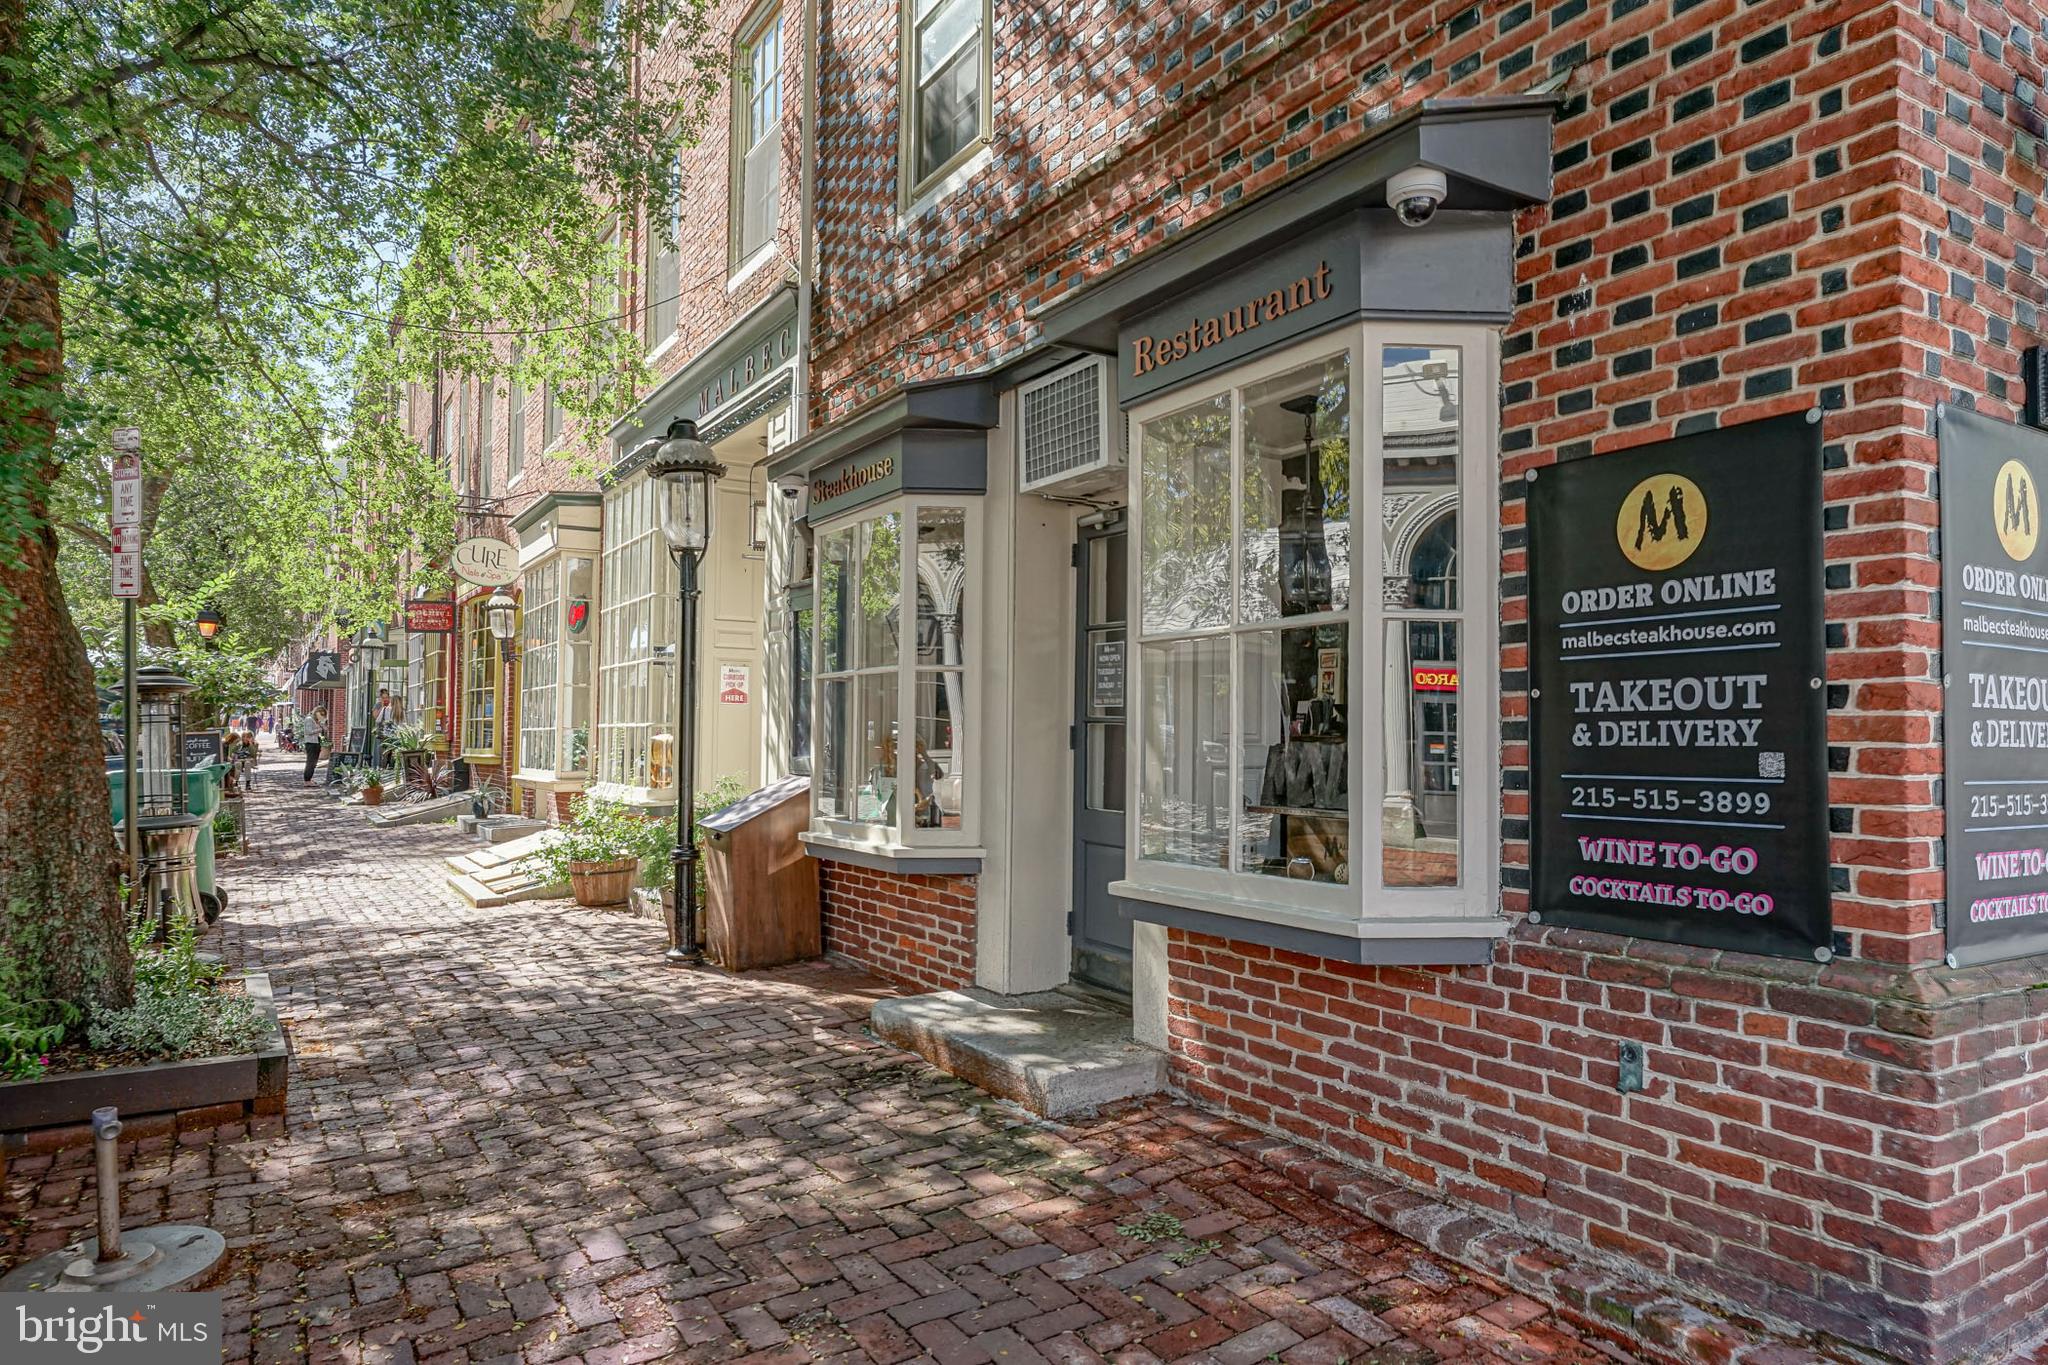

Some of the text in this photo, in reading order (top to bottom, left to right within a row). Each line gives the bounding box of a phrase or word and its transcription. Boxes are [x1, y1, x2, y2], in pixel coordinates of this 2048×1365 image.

[1132, 260, 1332, 377] Restaurant
[698, 328, 792, 419] MALBEC
[121, 483, 132, 494] ANY
[812, 456, 894, 505] Steakhouse
[120, 496, 134, 507] TIME
[113, 534, 121, 546] NO
[120, 555, 133, 566] ANY
[457, 545, 507, 569] CURE
[120, 568, 133, 578] TIME
[486, 569, 501, 580] Spa
[1962, 565, 2016, 597] ORDER
[1562, 568, 1776, 614] ORDER ONLINE
[1562, 621, 1776, 649] malbecsteakhouse.com
[1570, 674, 1767, 713] TAKEOUT
[1572, 718, 1763, 747] & DELIVERY
[1971, 720, 2048, 748] & DELIVE
[1571, 787, 1771, 815] 215-515-3899
[1578, 836, 1758, 875] WINE TO-GO
[1976, 848, 2048, 880] WINE TO-
[1569, 875, 1774, 916] COCKTAILS TO-GO
[1970, 893, 2036, 923] COCKTAILS
